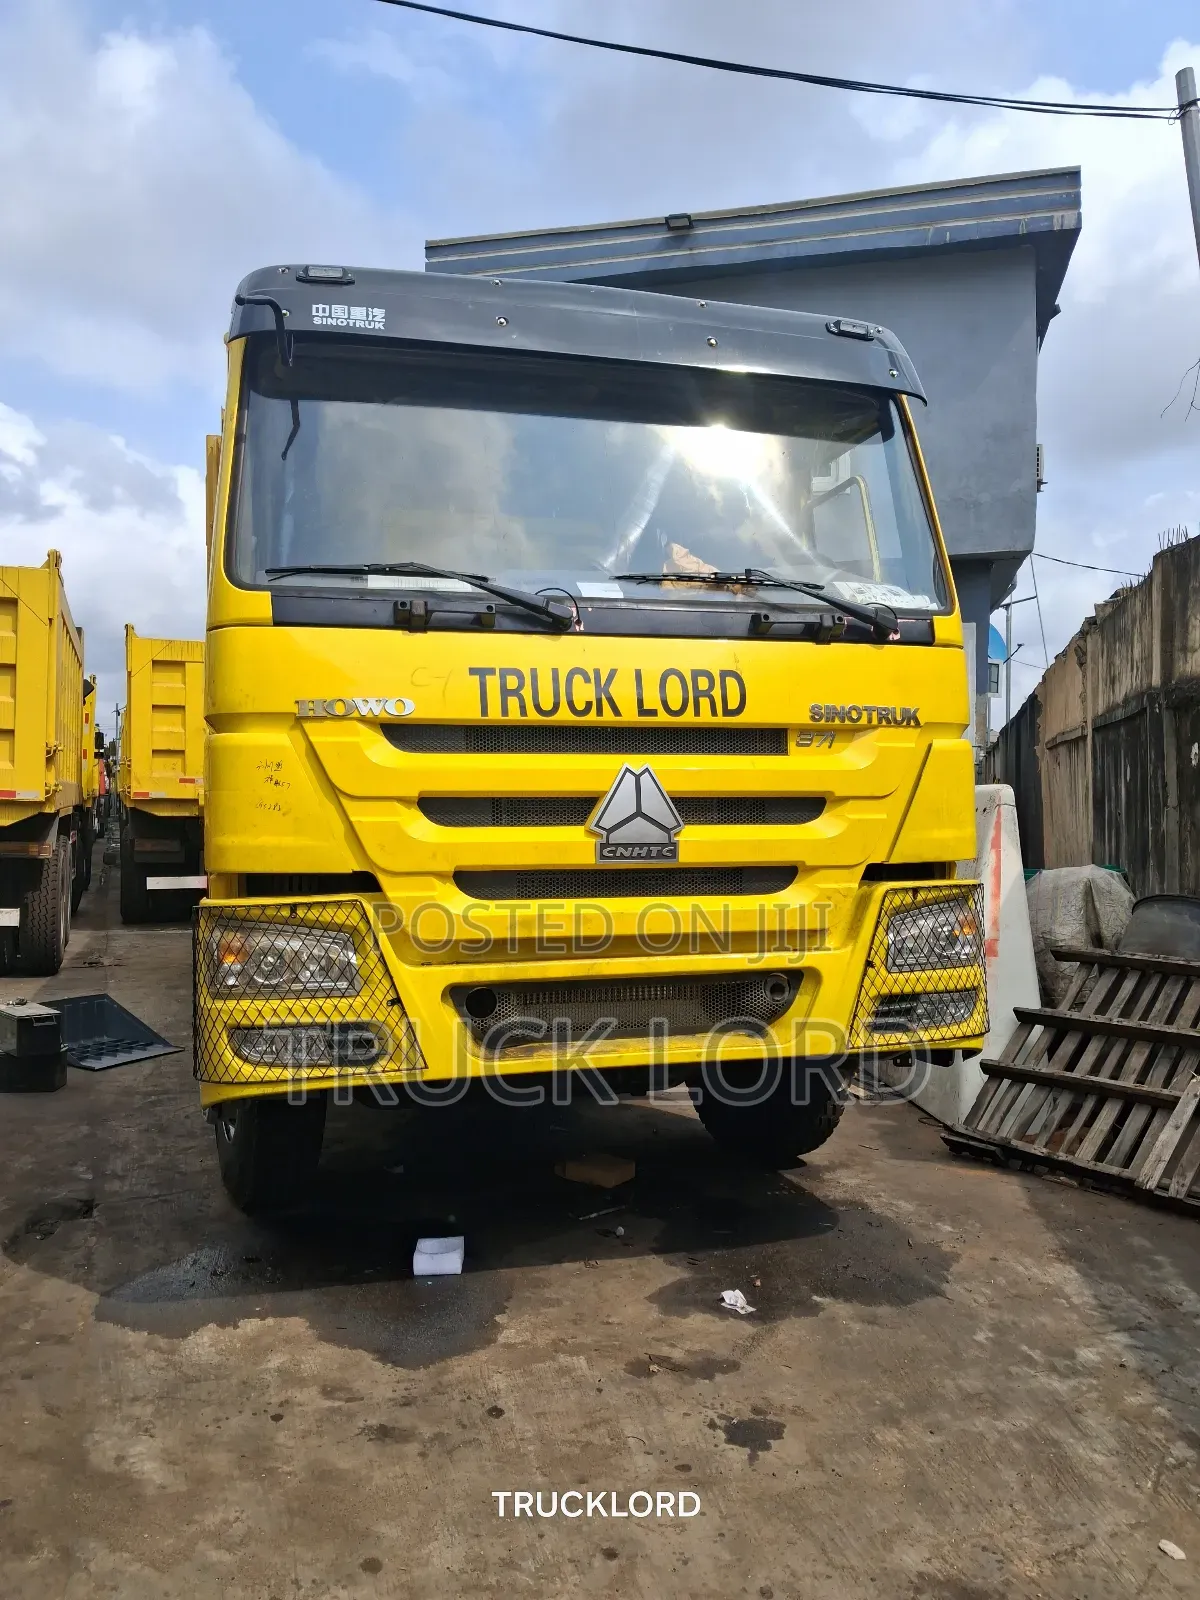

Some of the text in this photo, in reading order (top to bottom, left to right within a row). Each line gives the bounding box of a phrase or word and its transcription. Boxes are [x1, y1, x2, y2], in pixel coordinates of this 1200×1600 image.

[312, 304, 386, 322] 中国重汽
[313, 317, 385, 330] SINOTRUK
[469, 667, 747, 718] TRUCK LORD
[294, 697, 416, 718] HOWO
[809, 704, 921, 726] SINOTRUK
[602, 846, 675, 858] CNHTC
